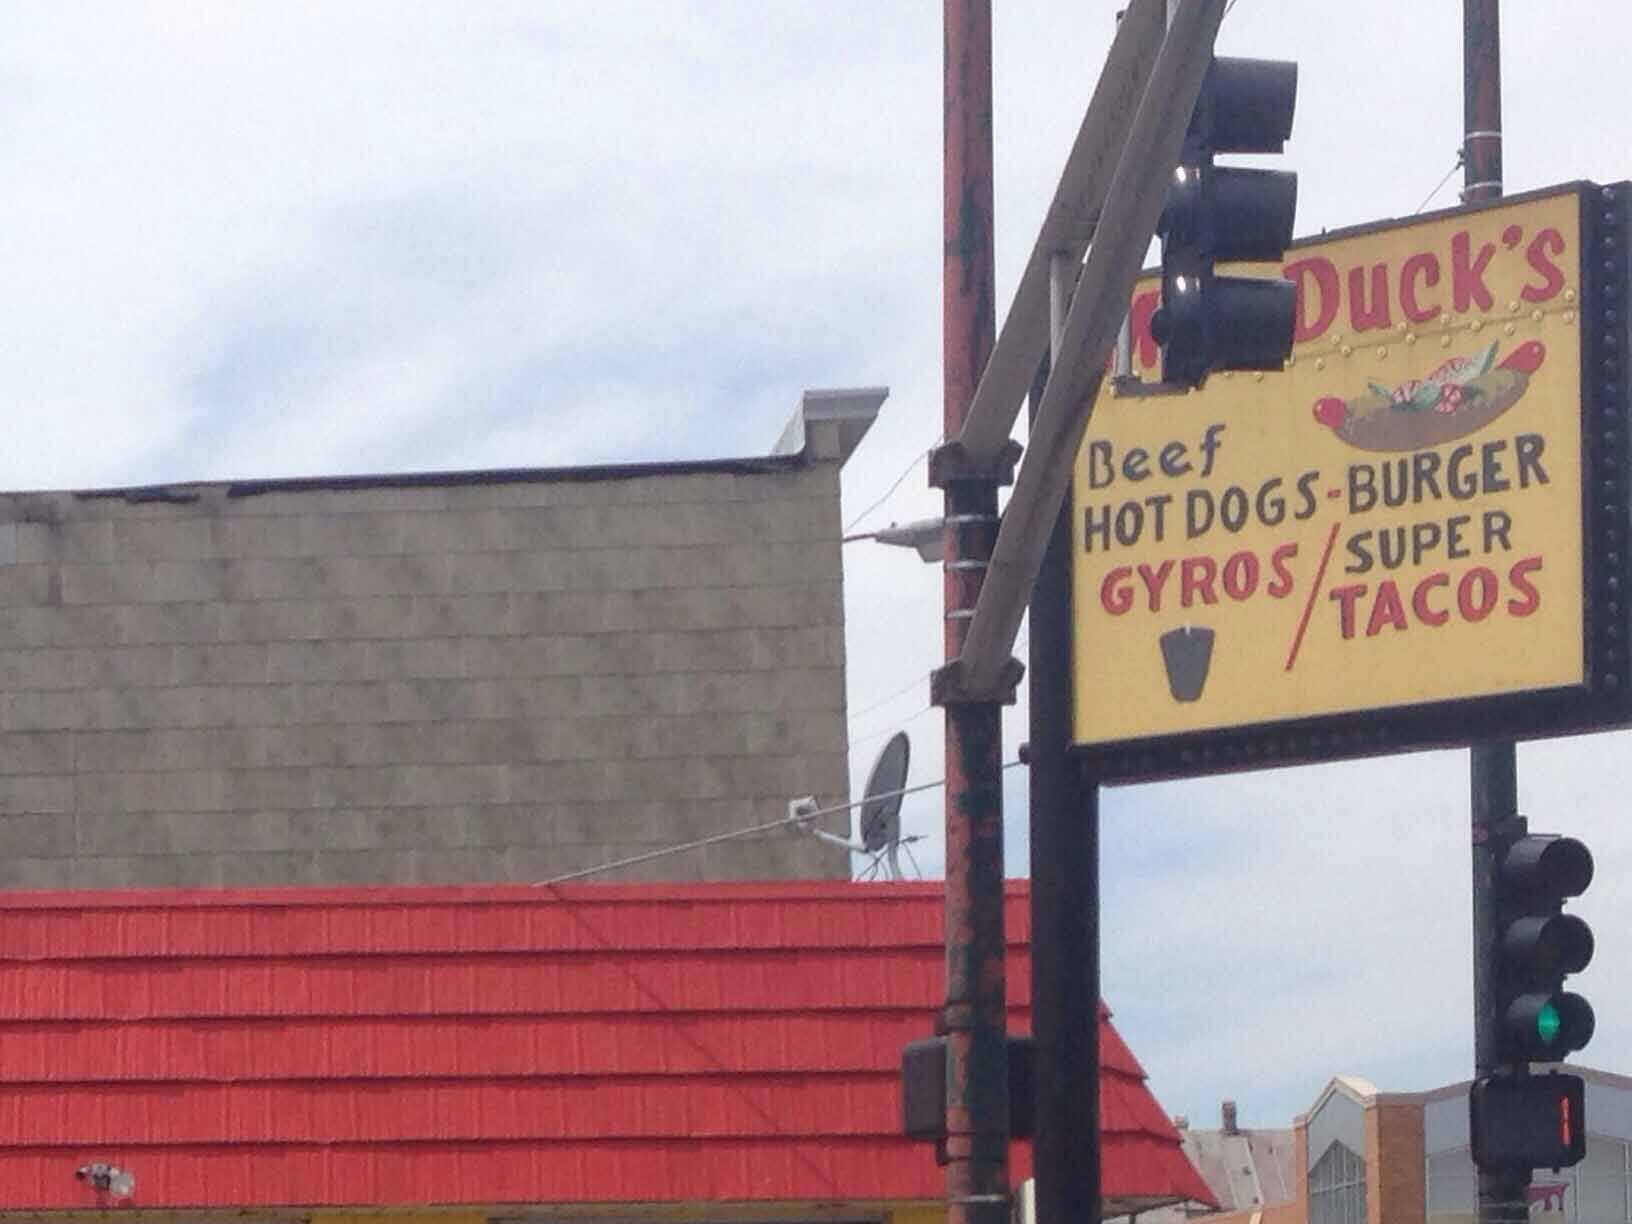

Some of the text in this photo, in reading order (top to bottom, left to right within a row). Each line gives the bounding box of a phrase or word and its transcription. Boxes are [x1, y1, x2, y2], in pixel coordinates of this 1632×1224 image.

[1088, 424, 1226, 489] Beef
[1083, 495, 1174, 553] HOT
[1344, 510, 1512, 574] SUPER
[1099, 542, 1298, 616] GYROS
[1329, 556, 1543, 639] TACOS
